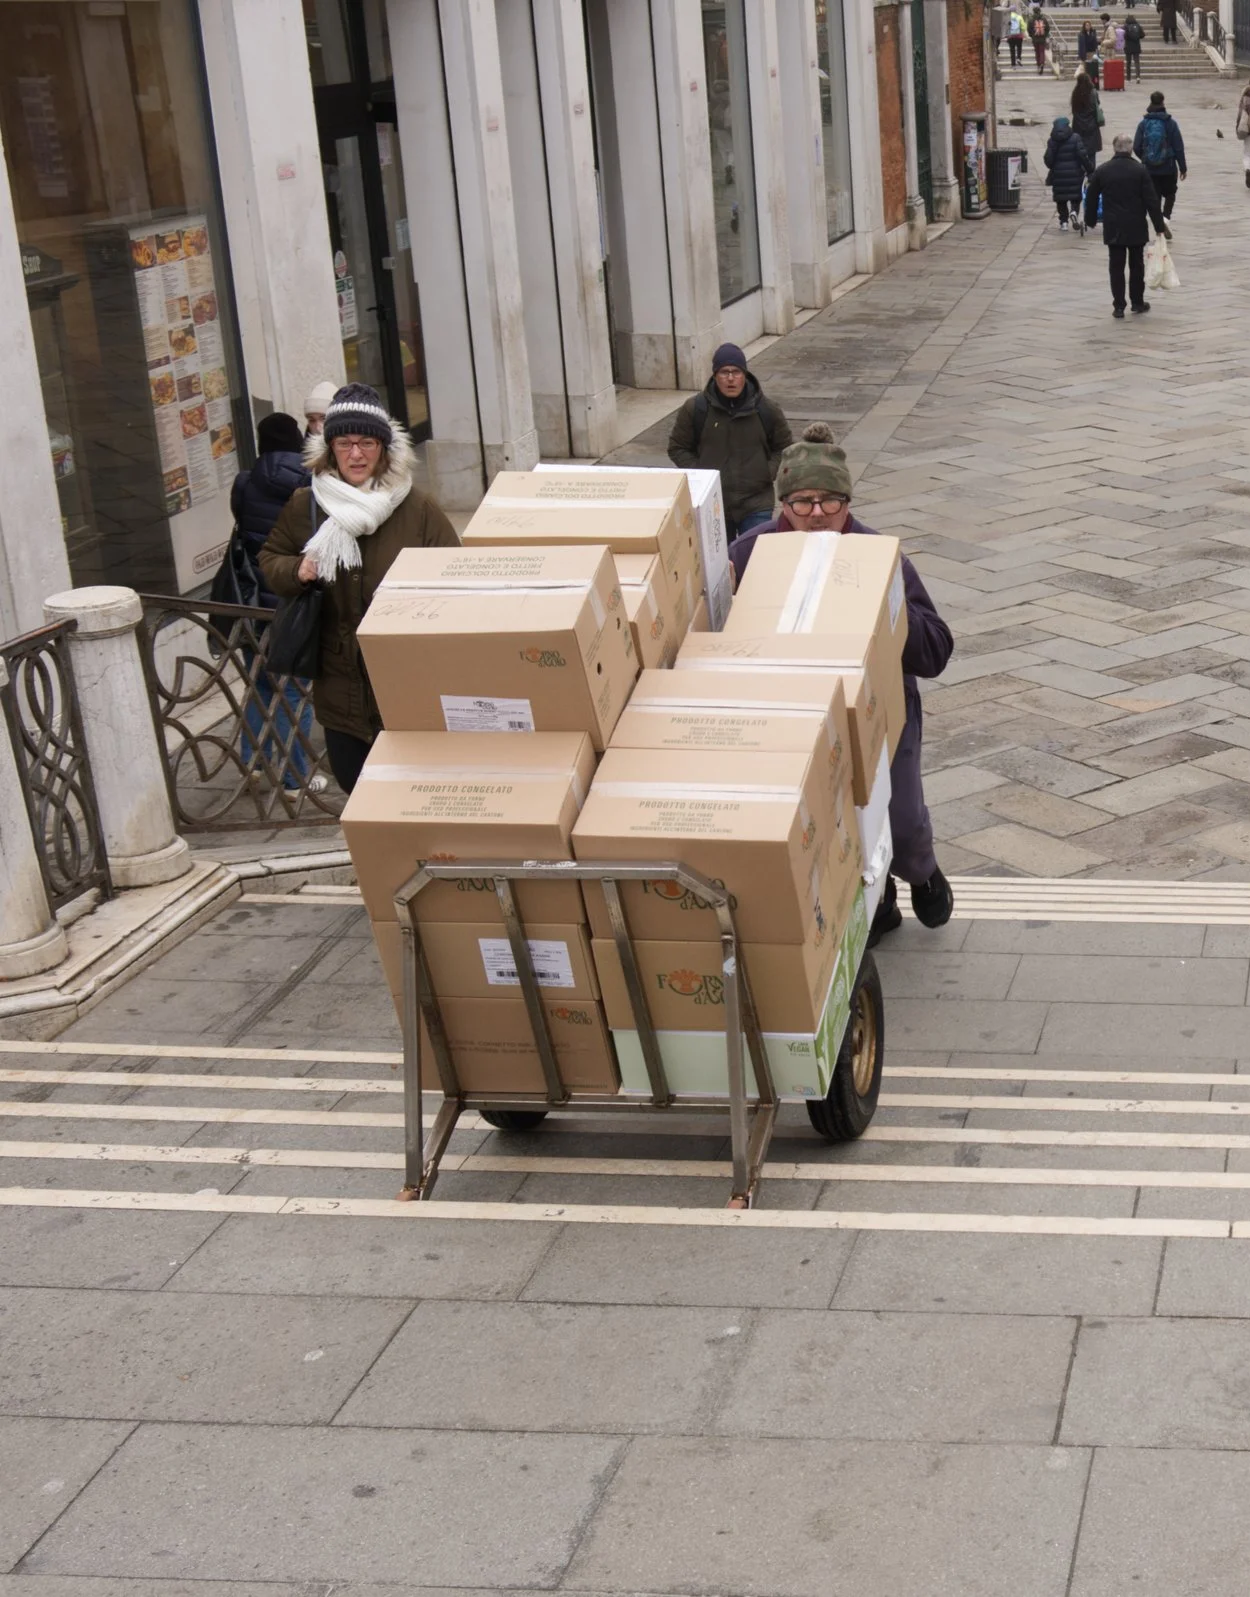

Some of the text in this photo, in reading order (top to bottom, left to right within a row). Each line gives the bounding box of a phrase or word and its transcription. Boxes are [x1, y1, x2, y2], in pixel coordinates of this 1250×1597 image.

[410, 784, 513, 794] PRODOTTO CONGELATO
[639, 800, 740, 811] PRODOTTO CONGELATO
